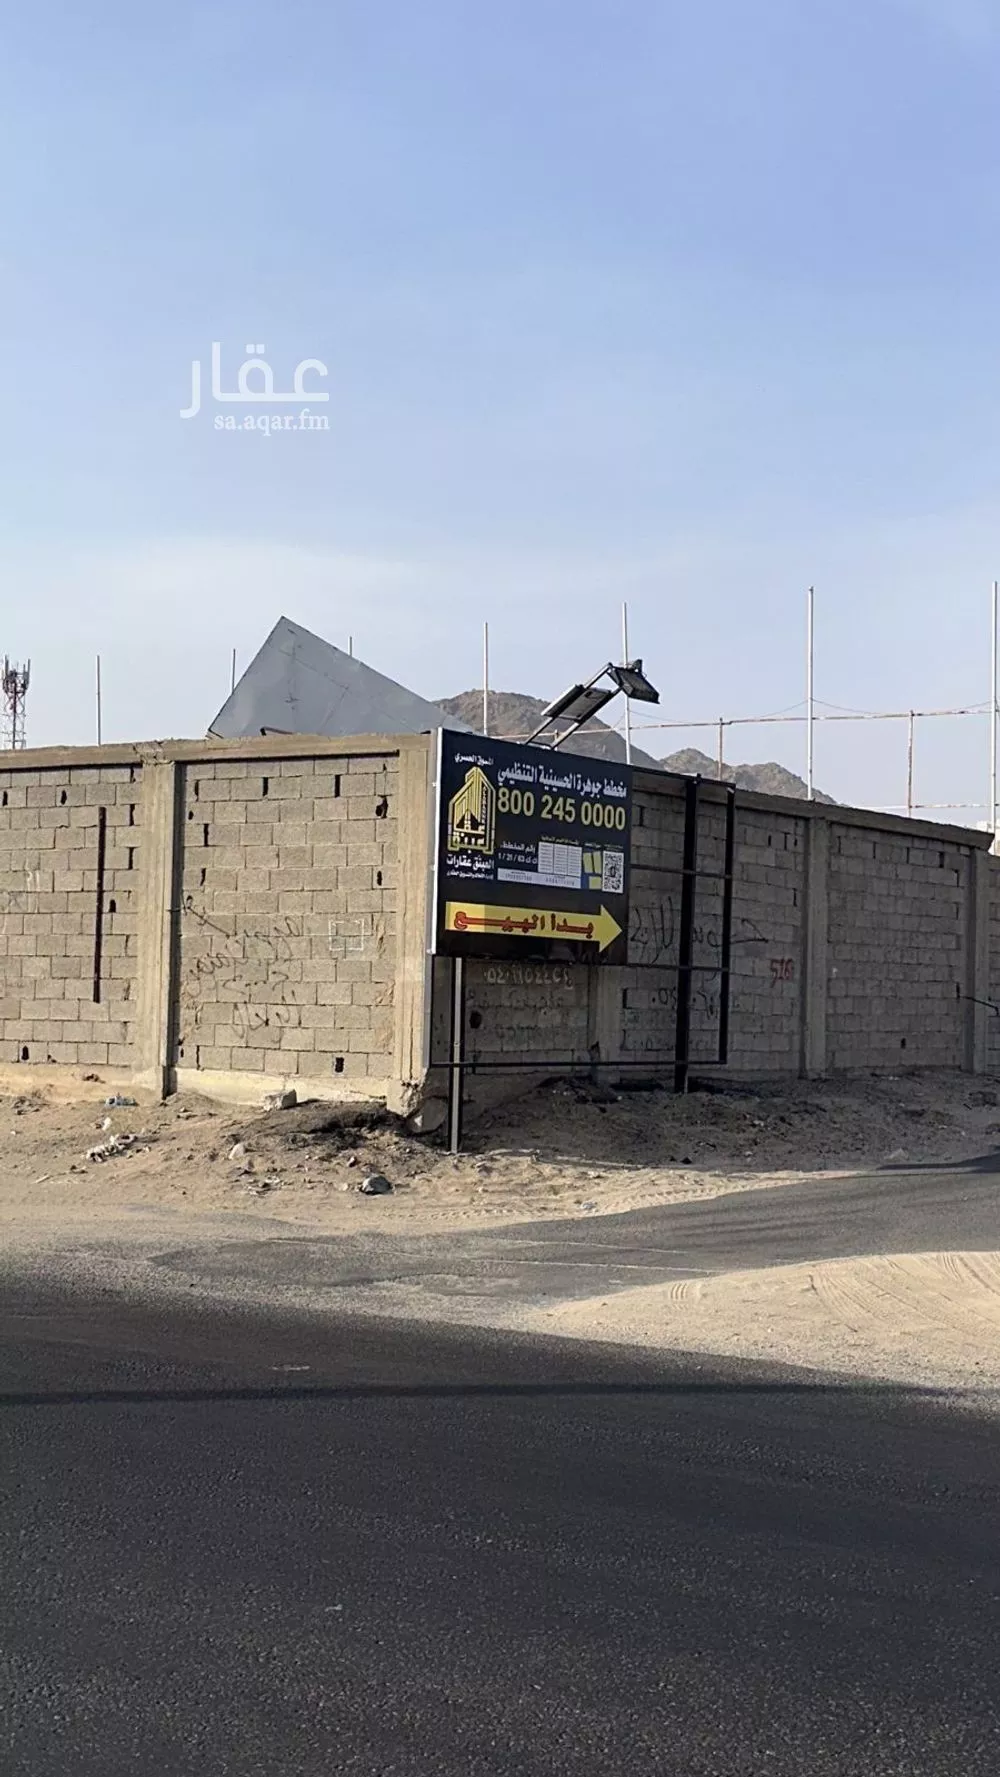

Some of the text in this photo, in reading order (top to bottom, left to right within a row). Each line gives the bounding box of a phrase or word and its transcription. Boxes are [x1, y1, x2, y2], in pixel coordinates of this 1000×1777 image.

[497, 762, 628, 798] مخطط جوهرة الحسينية التنظيمي
[498, 787, 535, 817] 800
[541, 795, 576, 823] 245
[581, 801, 626, 831] 0000
[446, 854, 472, 868] عقارات
[453, 911, 546, 933] البيع
